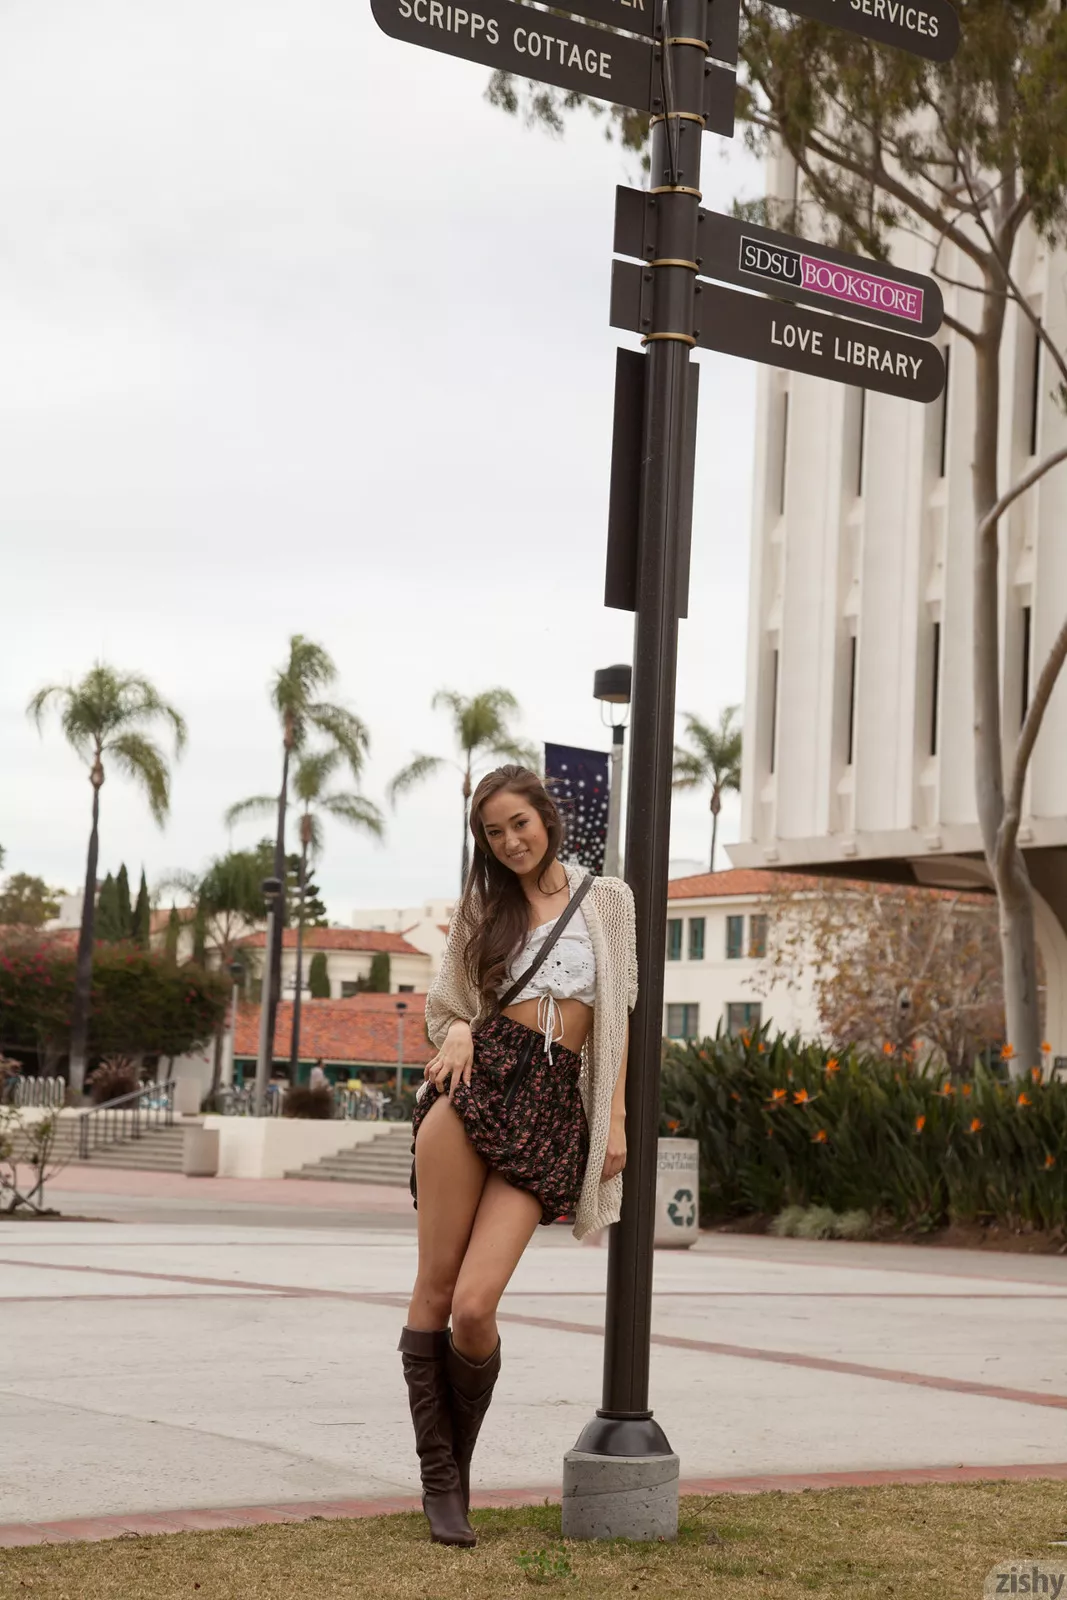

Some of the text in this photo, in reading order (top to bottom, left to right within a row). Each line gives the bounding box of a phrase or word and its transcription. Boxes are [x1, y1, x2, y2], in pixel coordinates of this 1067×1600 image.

[399, 0, 612, 79] SCRIPPS COTTAGE
[744, 245, 917, 314] SDSU BOOKSTORE
[771, 320, 923, 380] LOVE LIBRARY
